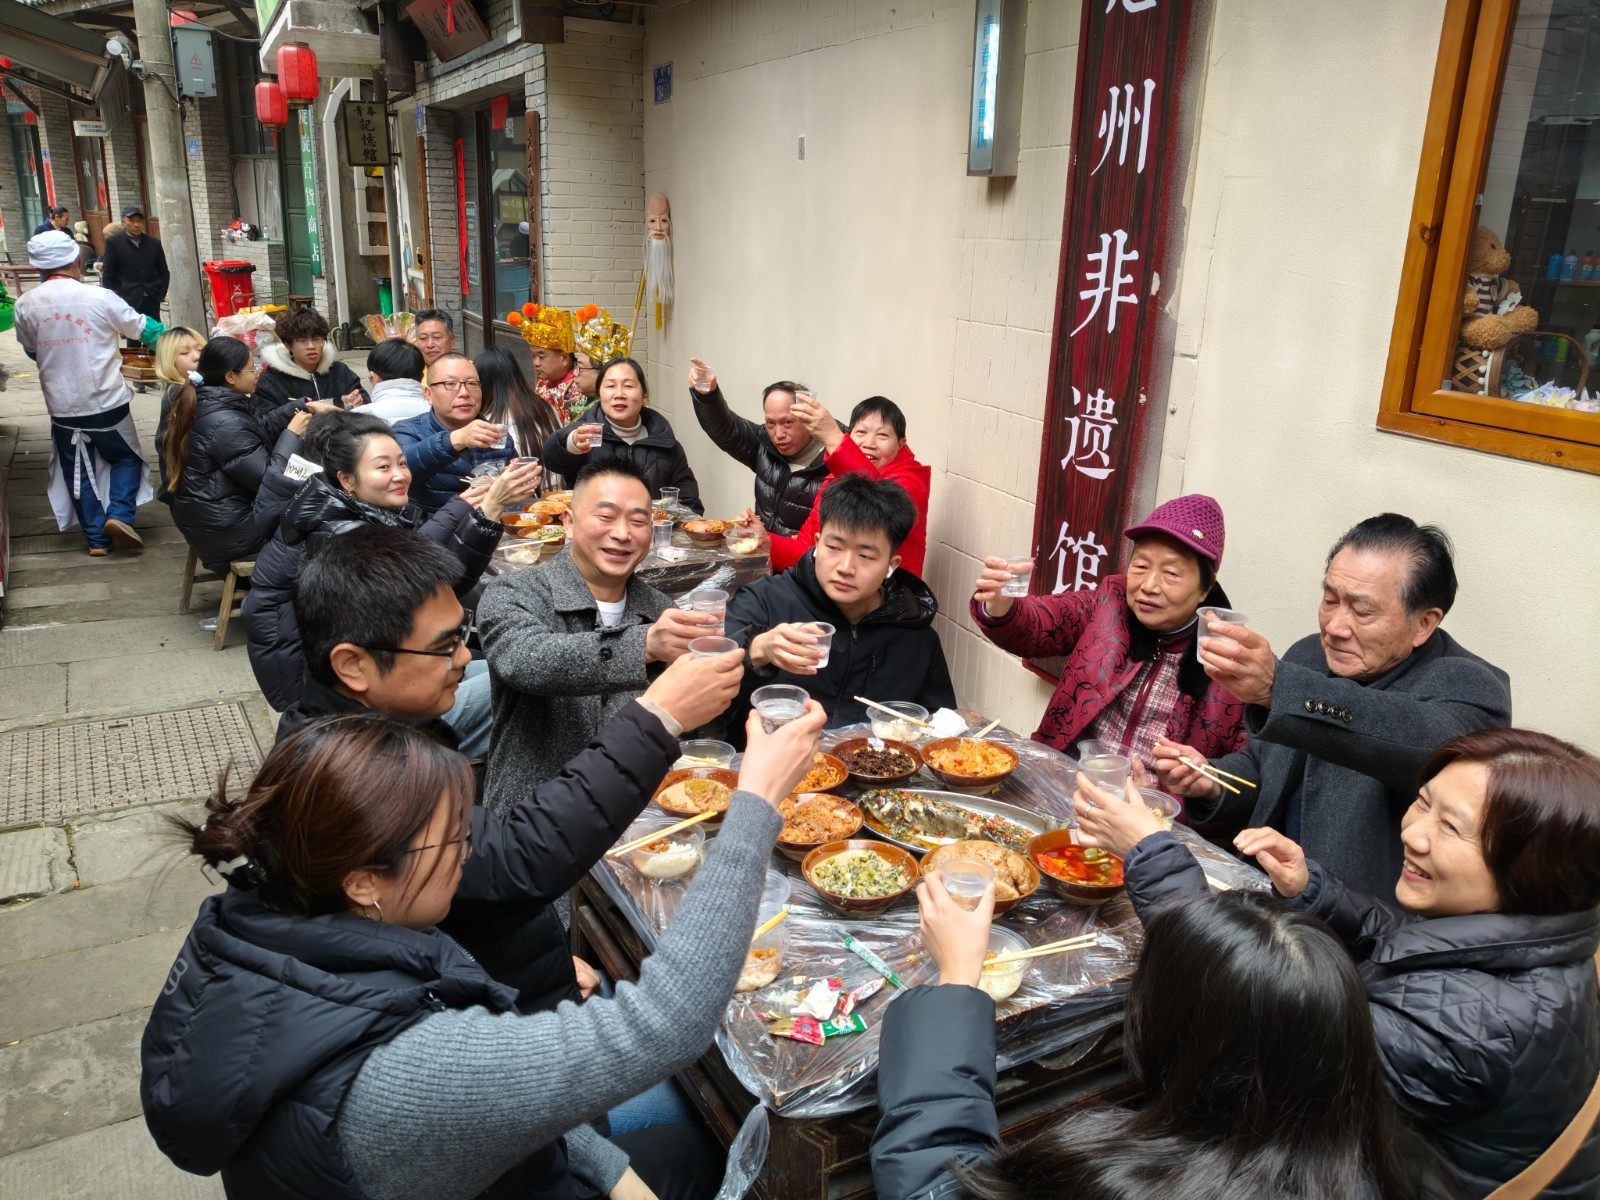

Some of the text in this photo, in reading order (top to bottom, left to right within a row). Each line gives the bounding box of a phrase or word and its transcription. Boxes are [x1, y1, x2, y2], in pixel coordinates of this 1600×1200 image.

[360, 118, 378, 162] 記憶館
[1049, 0, 1157, 595] 州非遗馆
